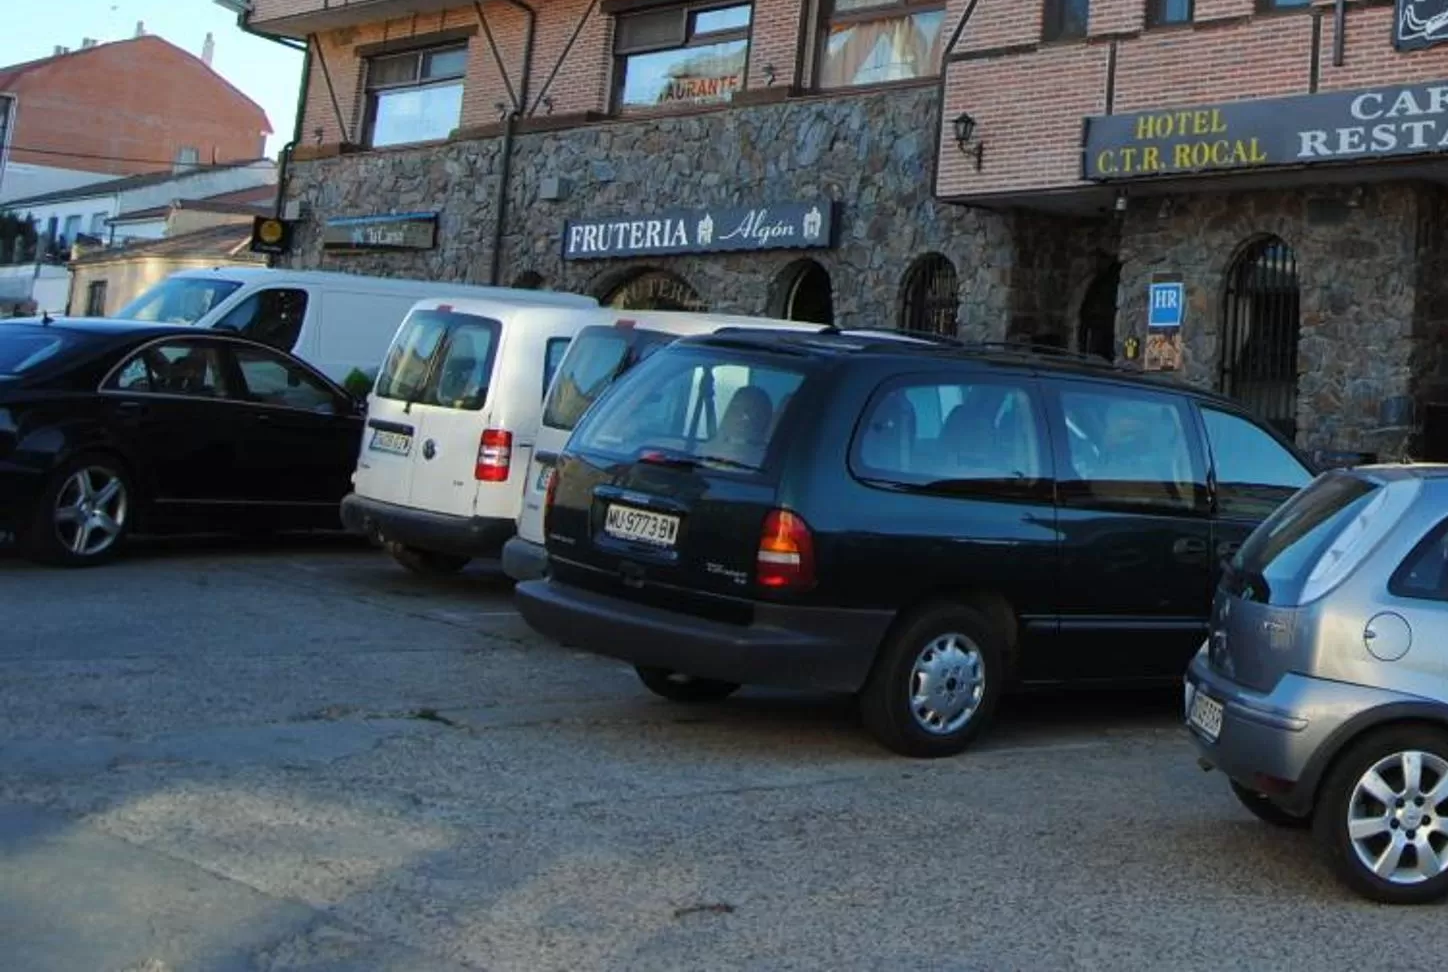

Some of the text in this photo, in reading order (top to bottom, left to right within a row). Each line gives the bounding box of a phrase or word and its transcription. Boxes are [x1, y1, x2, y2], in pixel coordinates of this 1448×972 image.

[1135, 108, 1229, 141] HOTEL
[1174, 137, 1268, 170] ROCAL
[568, 208, 796, 253] FRUTERIA Algón
[1155, 289, 1178, 309] HR
